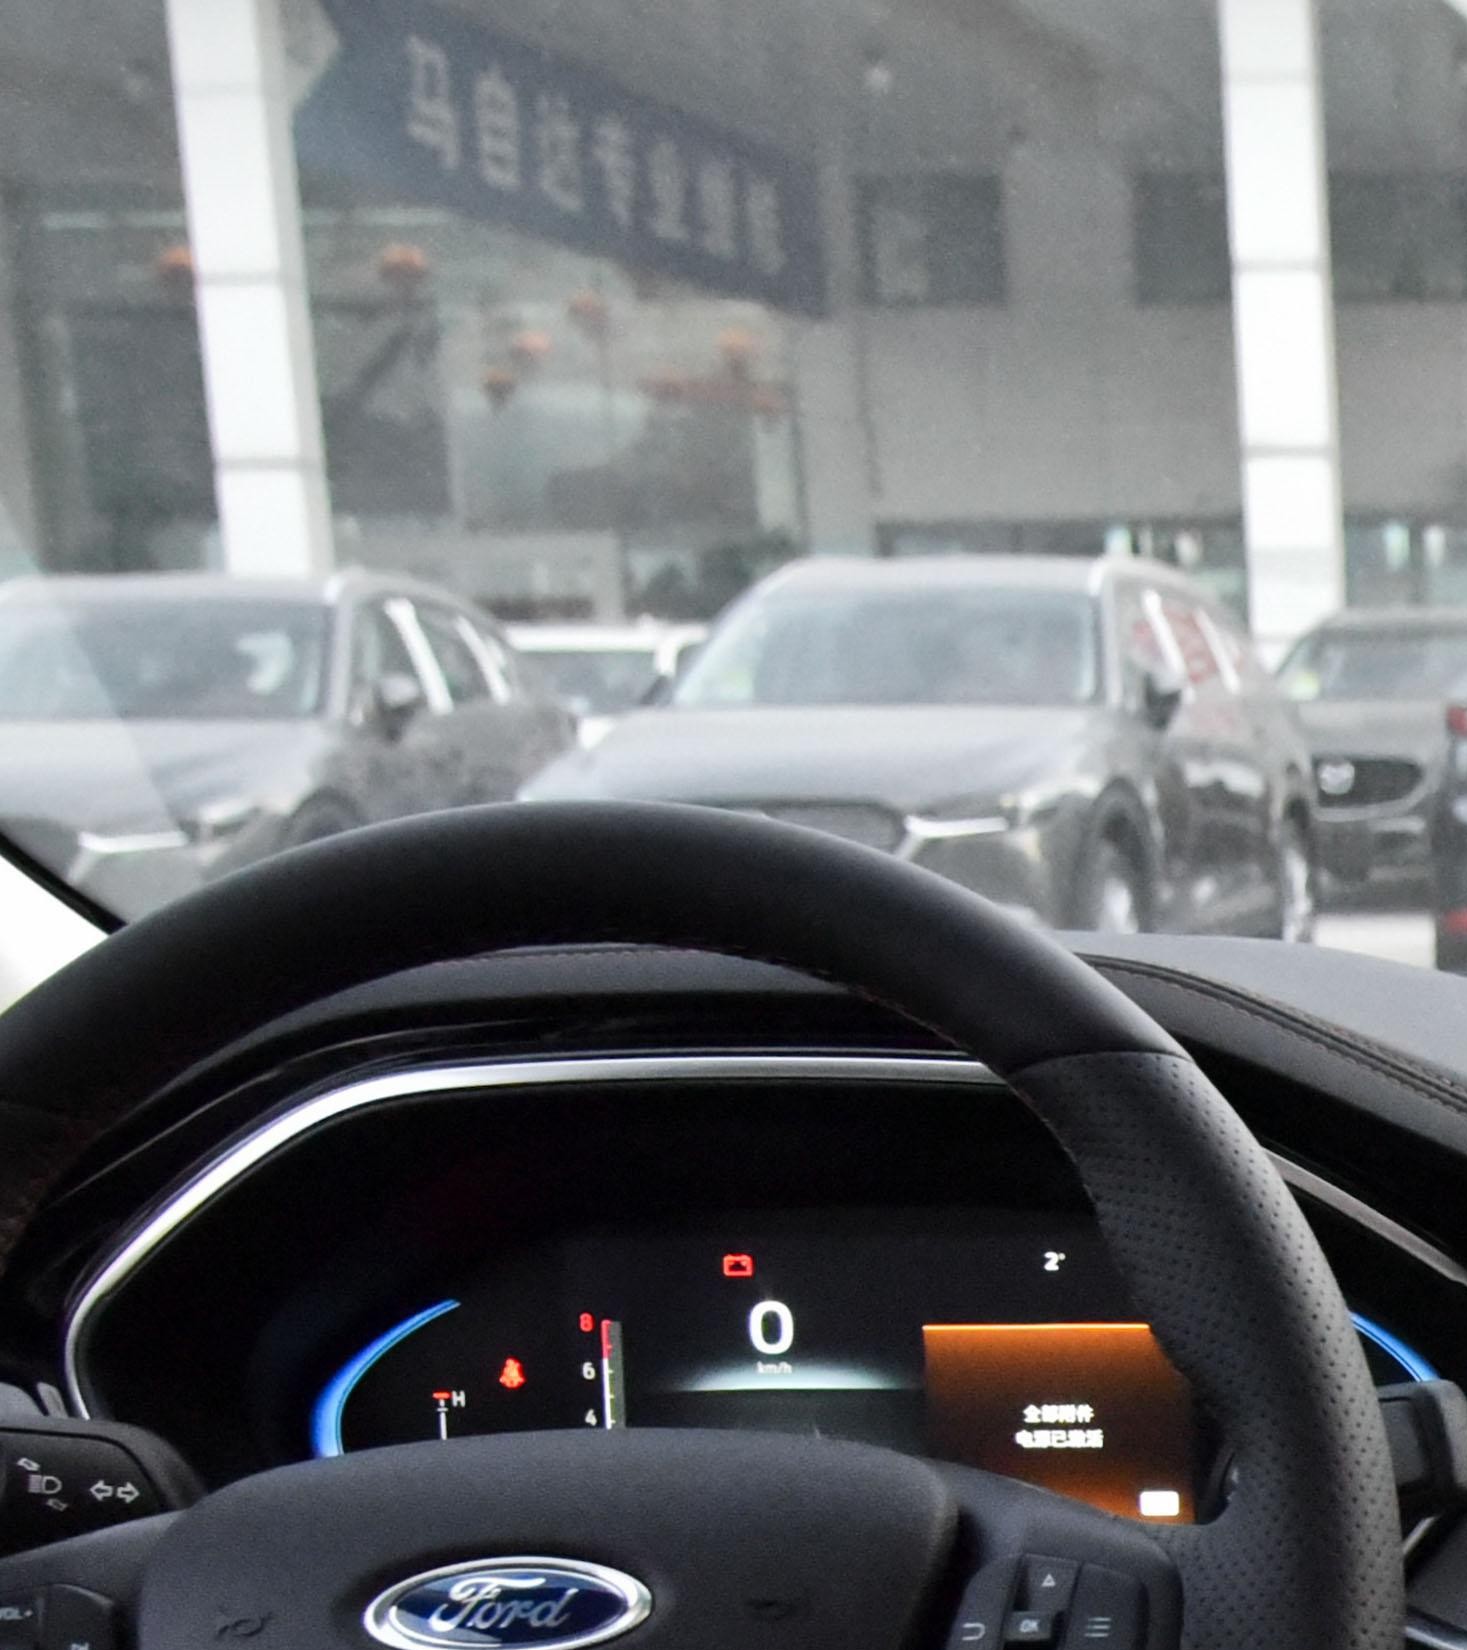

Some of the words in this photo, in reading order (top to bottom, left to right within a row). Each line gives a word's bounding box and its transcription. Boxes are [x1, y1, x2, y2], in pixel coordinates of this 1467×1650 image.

[579, 1312, 595, 1333] 8
[748, 1300, 794, 1355] 0
[582, 1362, 596, 1380] 6
[757, 1360, 793, 1375] km/h
[451, 1390, 466, 1408] H
[584, 1409, 598, 1426] 4
[428, 1577, 578, 1632] Ford
[1019, 1618, 1039, 1633] OK
